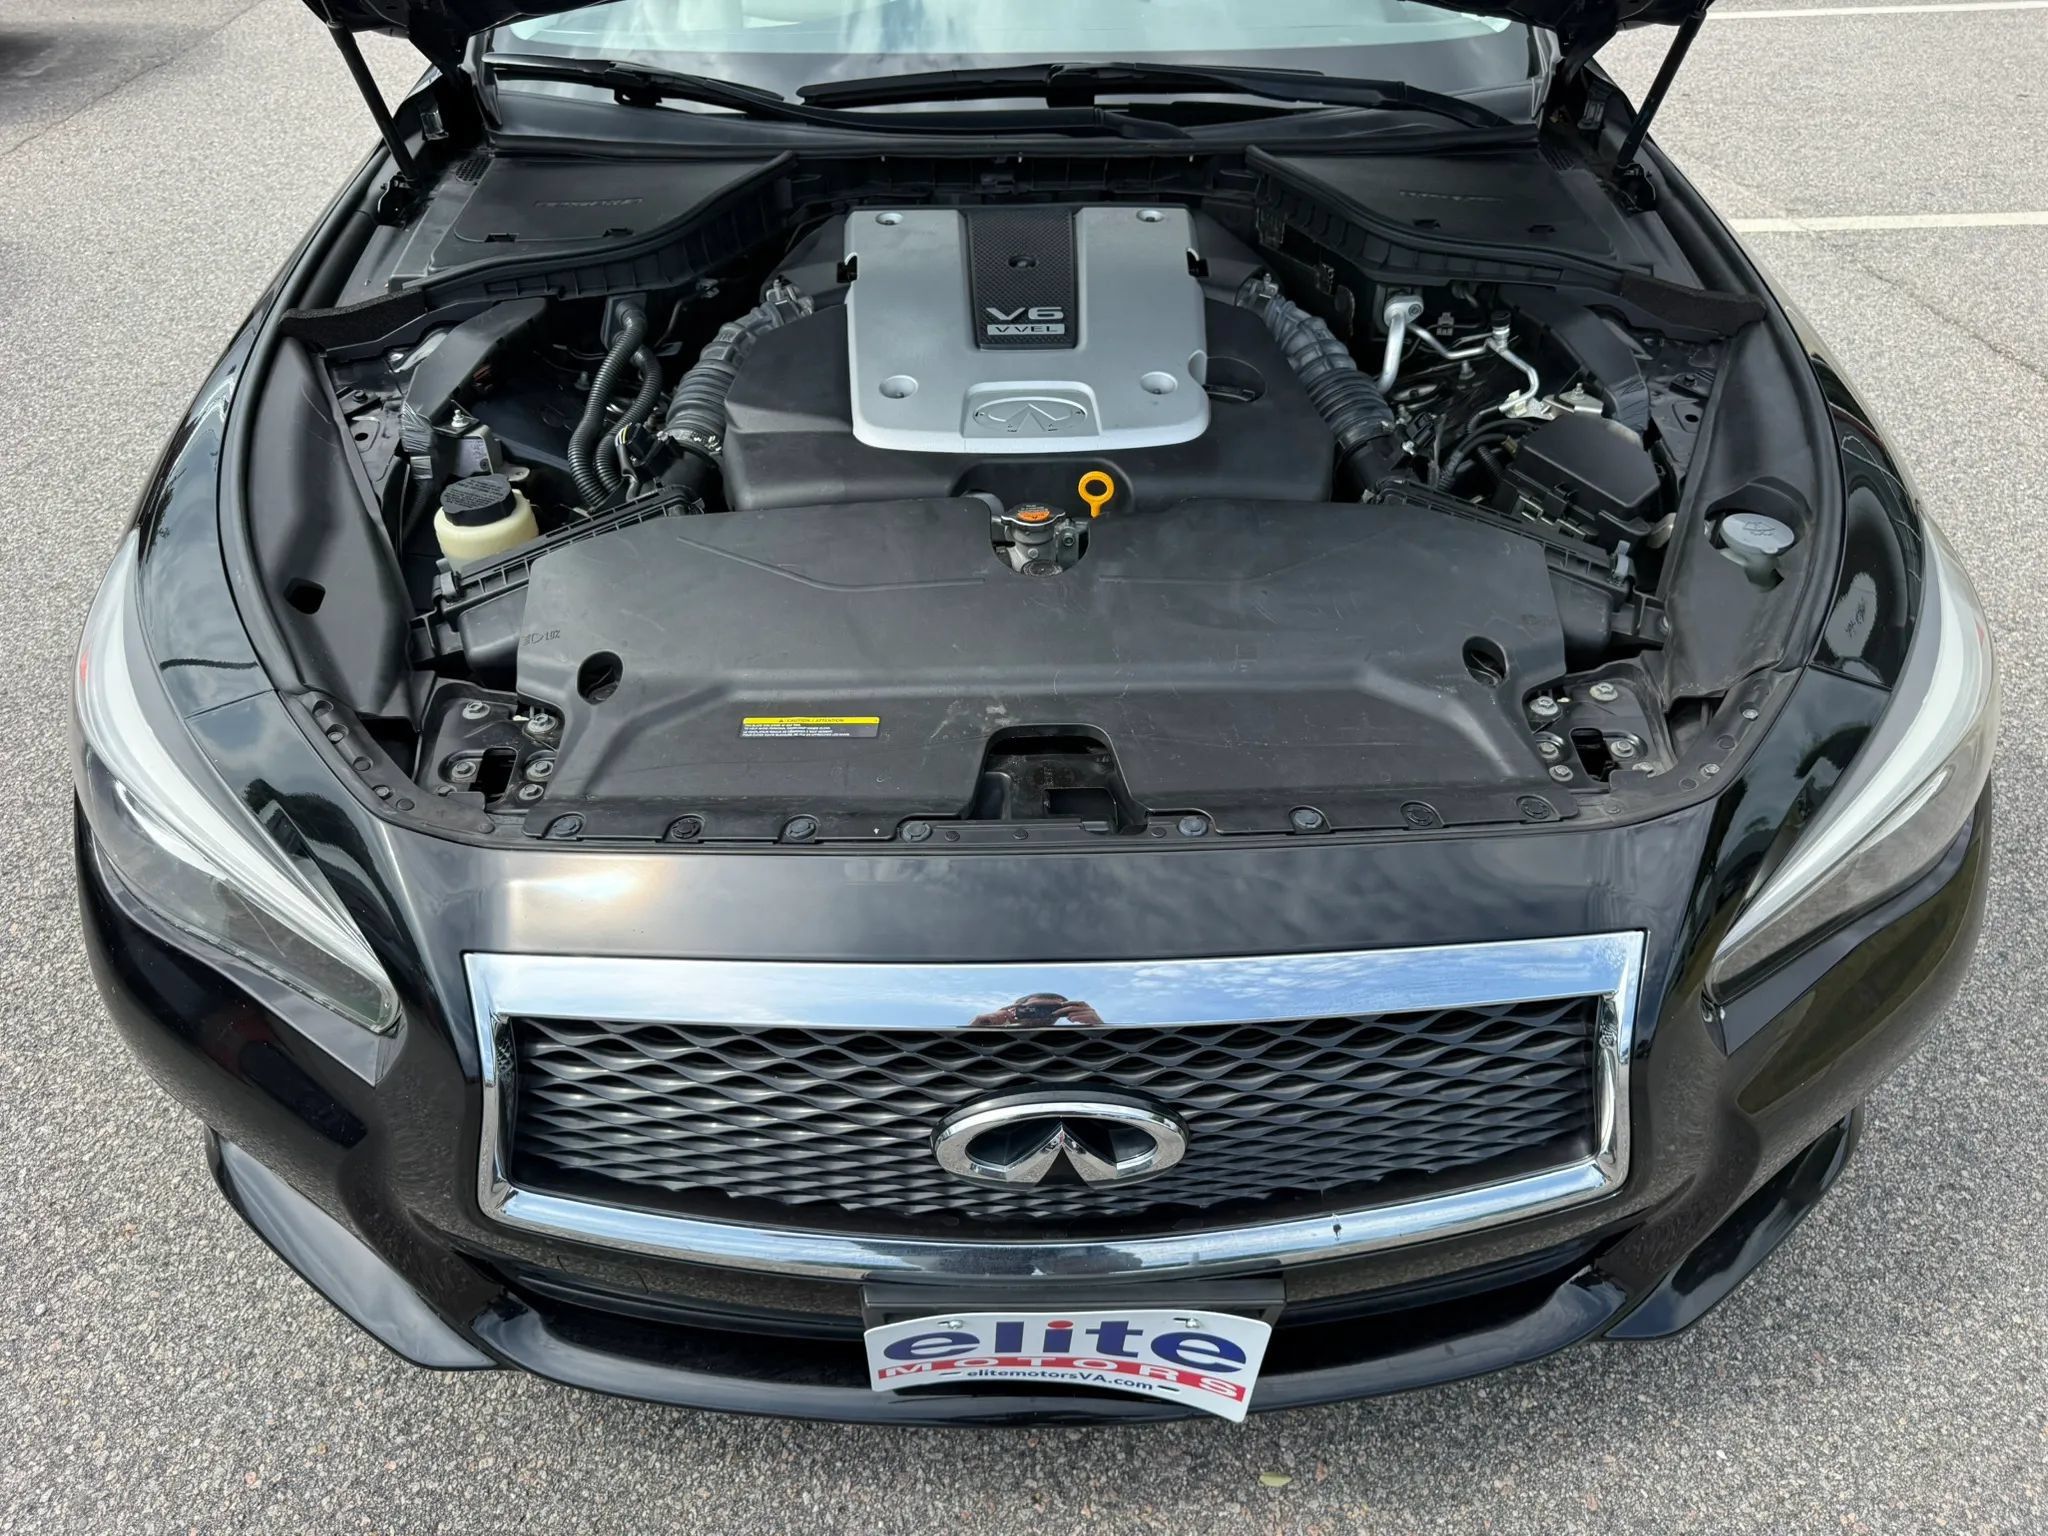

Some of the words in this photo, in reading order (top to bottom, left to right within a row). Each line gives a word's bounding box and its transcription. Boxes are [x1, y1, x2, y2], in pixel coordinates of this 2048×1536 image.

[986, 307, 1064, 320] V6
[883, 1320, 1247, 1373] elite
[884, 1356, 1240, 1400] MOTORS
[967, 1369, 1153, 1391] elitemotorsVA.com
